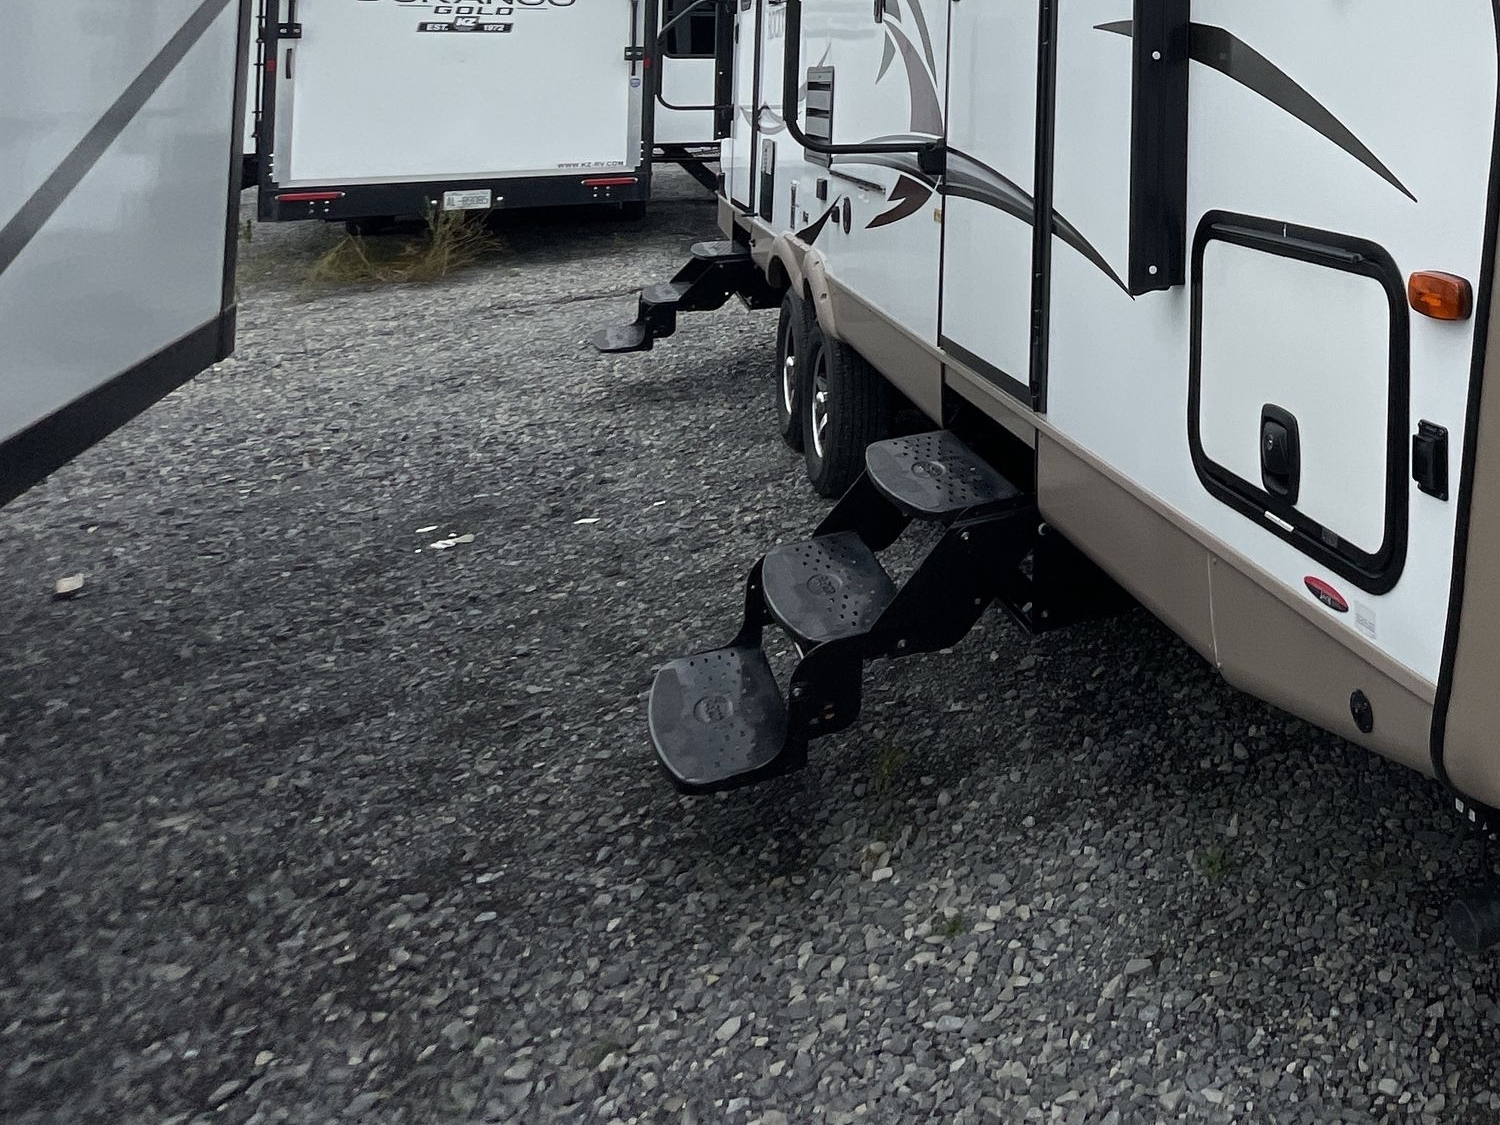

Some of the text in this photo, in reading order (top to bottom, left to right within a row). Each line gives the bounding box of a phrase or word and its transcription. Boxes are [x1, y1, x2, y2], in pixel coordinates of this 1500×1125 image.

[433, 6, 514, 16] GOLD
[455, 16, 477, 27] KZ
[426, 23, 505, 32] EST. 1972
